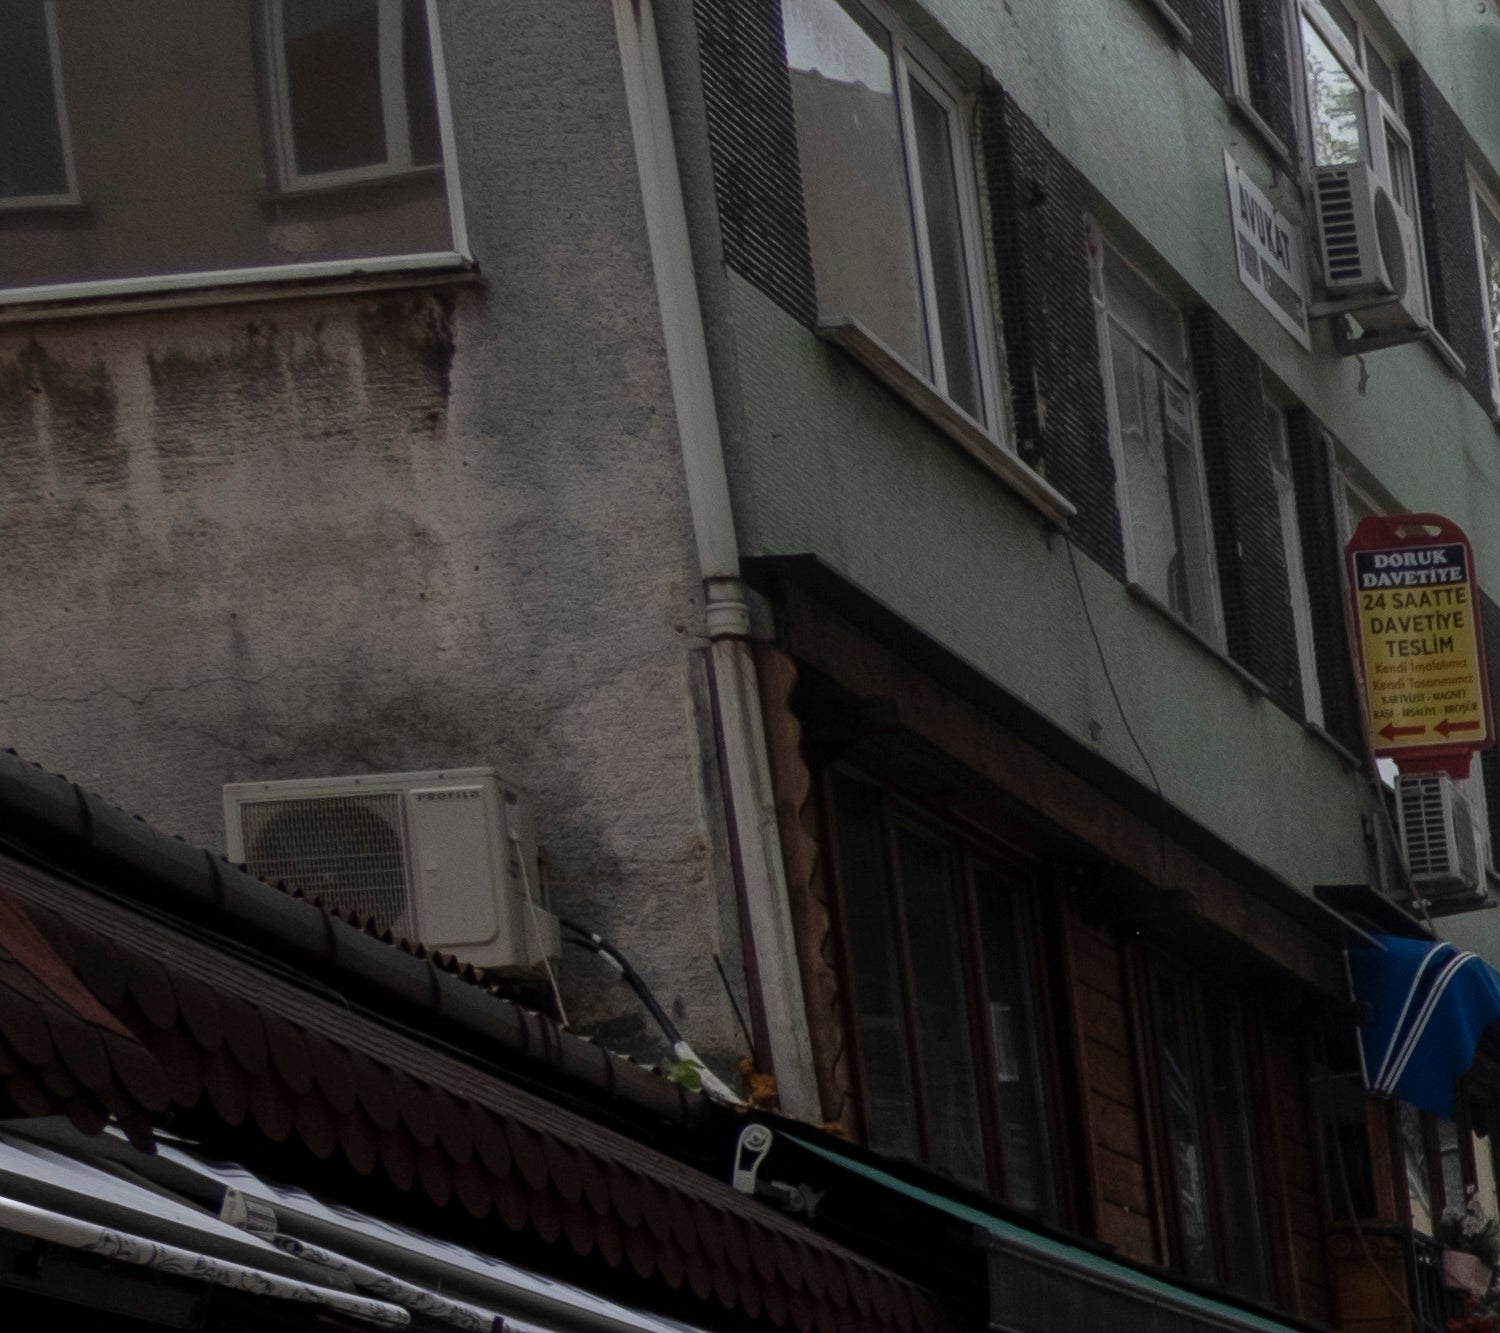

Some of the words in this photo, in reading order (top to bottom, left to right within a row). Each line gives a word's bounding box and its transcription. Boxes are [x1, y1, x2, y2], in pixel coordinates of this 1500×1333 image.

[1238, 183, 1292, 275] AVUKAT
[1374, 549, 1448, 569] DORUK
[1362, 566, 1463, 588] DAVETİYE
[1363, 594, 1387, 611] 24
[1392, 587, 1467, 610] SAATTE
[1370, 610, 1465, 634] DAVETİYE
[1385, 634, 1454, 657] TESLİM
